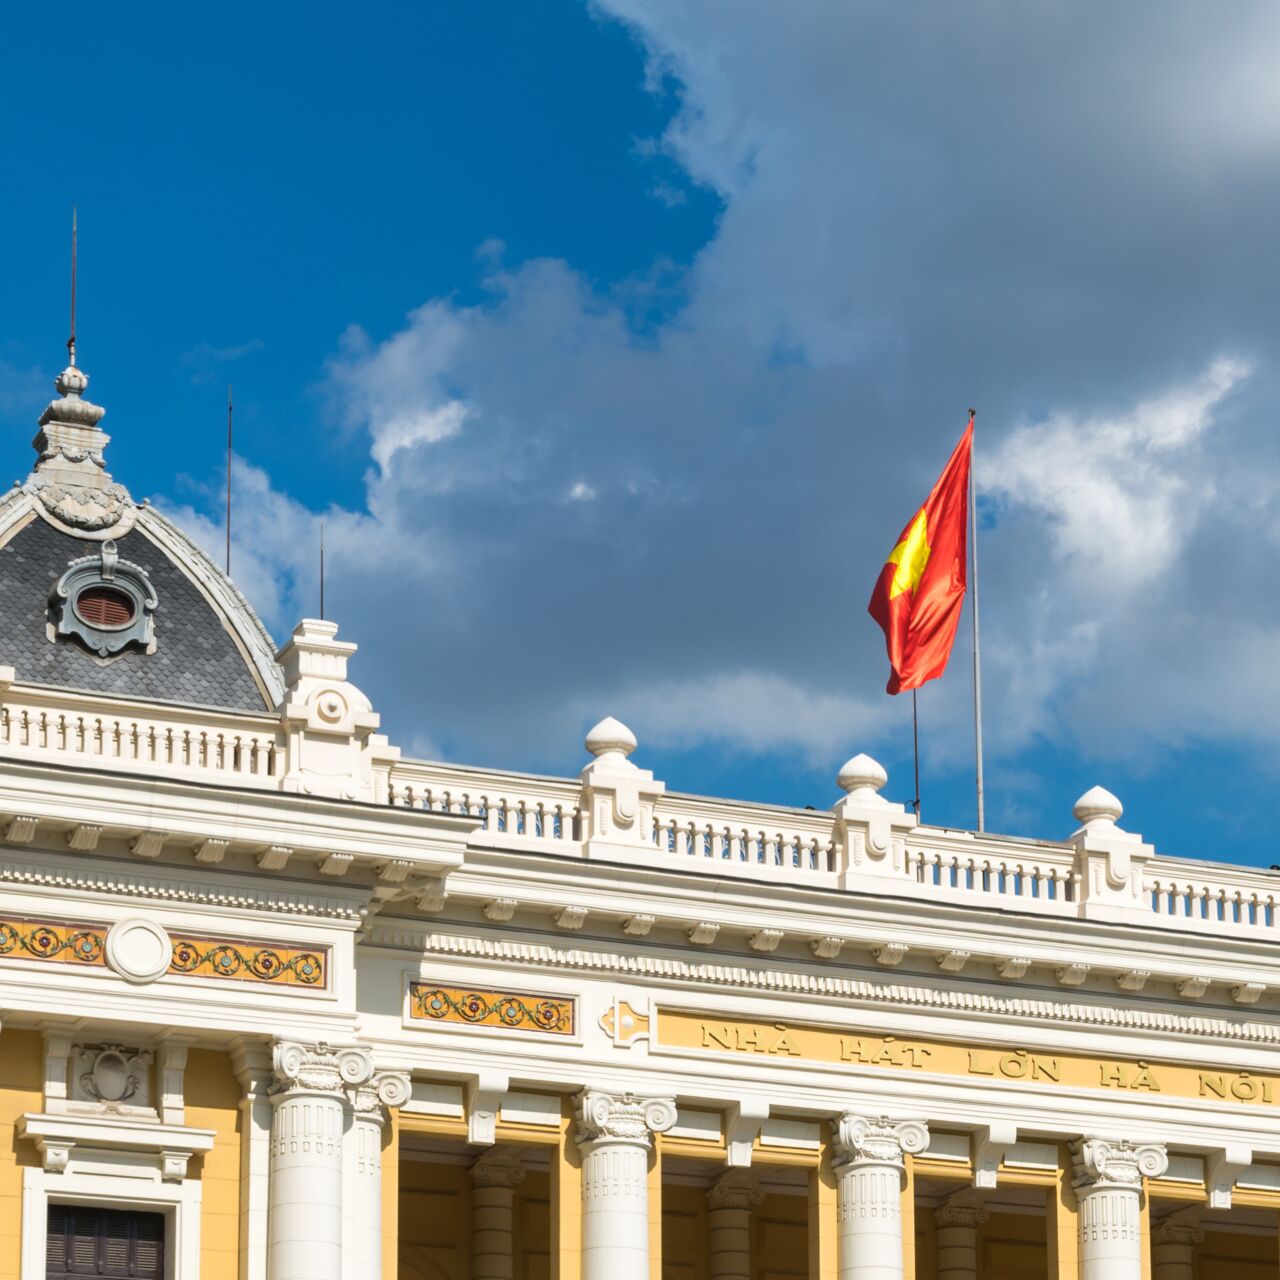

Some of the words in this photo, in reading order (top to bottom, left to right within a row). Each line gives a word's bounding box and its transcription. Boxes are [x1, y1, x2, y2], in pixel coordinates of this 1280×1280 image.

[701, 1022, 801, 1057] NHÀ
[839, 1035, 932, 1068] HÁT
[1100, 1060, 1161, 1092] HÀ
